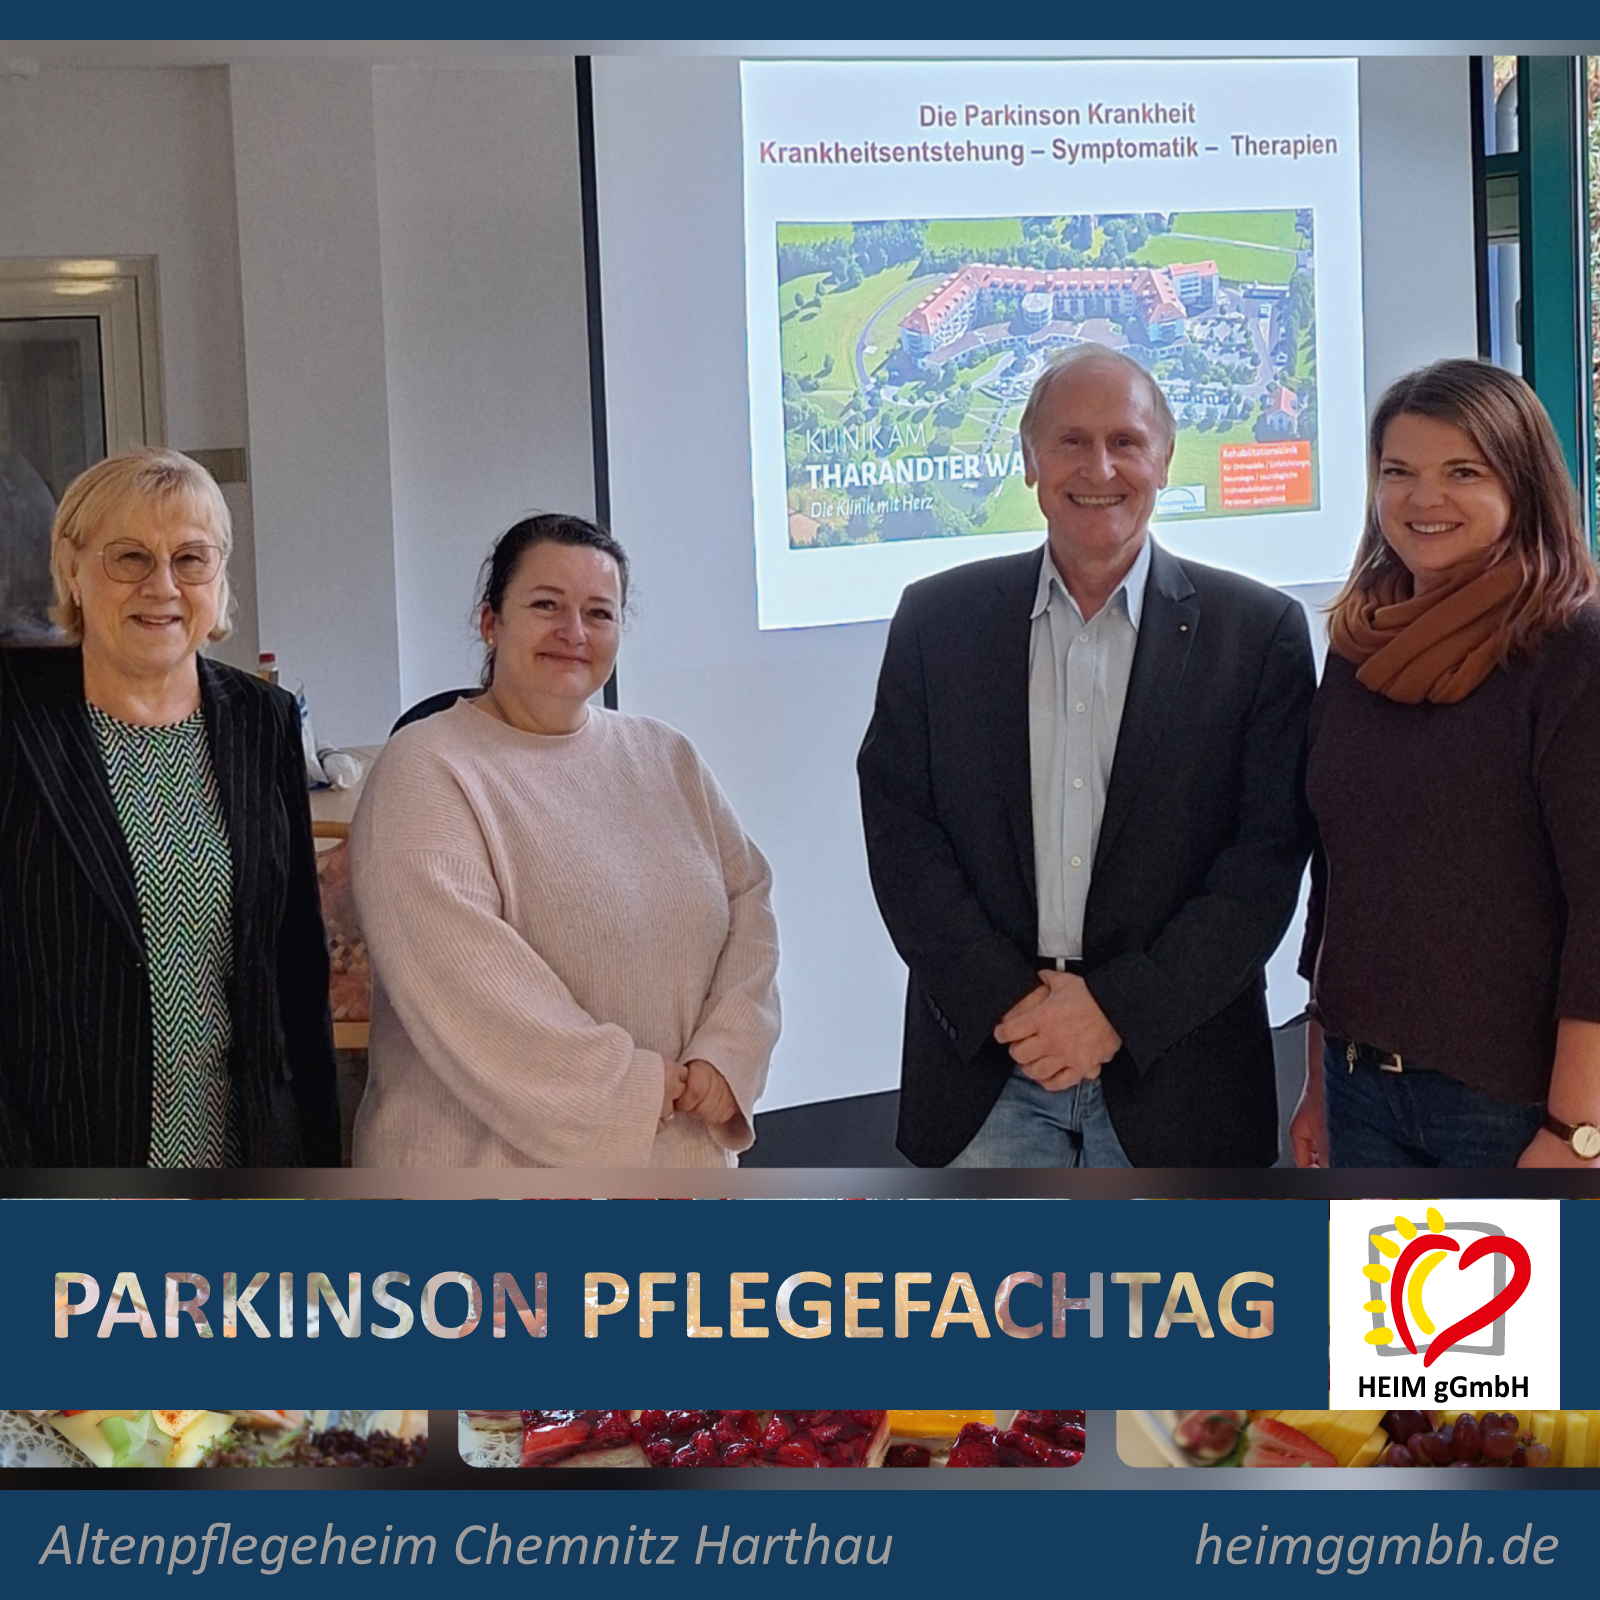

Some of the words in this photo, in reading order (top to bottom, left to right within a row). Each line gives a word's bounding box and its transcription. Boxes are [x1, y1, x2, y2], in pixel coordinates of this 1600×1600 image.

[920, 105, 957, 128] Die
[965, 103, 1081, 127] Parkinson
[1088, 101, 1196, 125] Krankheit
[759, 139, 1025, 167] Krankheitsentstehung
[1052, 136, 1200, 165] Symptomatik
[1230, 132, 1338, 160] Therapien
[805, 425, 883, 454] KLINIK
[888, 422, 926, 449] AM
[805, 454, 981, 489] THARANDTER
[984, 451, 1026, 477] WA
[811, 500, 833, 518] Die
[836, 496, 874, 517] Klinik
[877, 496, 900, 514] mit
[902, 493, 934, 512] Herz
